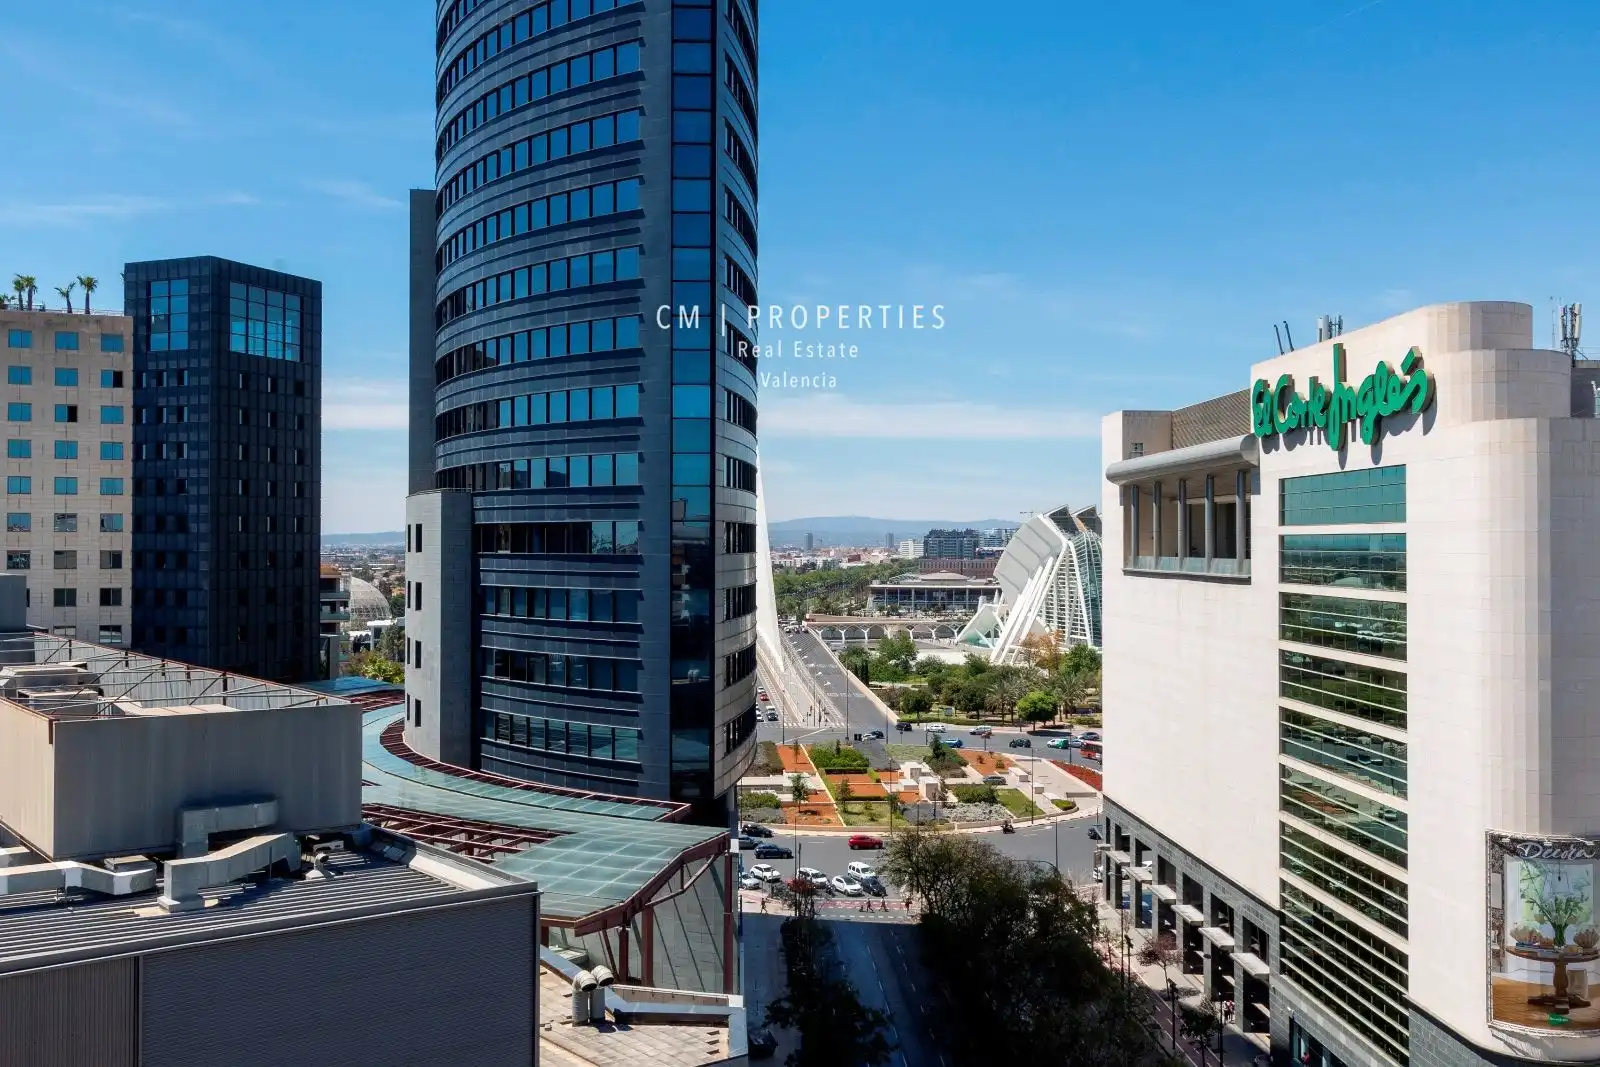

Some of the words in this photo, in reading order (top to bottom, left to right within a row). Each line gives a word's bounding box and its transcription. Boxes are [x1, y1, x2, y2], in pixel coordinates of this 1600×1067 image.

[1252, 378, 1274, 439] El
[1273, 373, 1329, 435] Corte
[1328, 342, 1430, 452] Inglés
